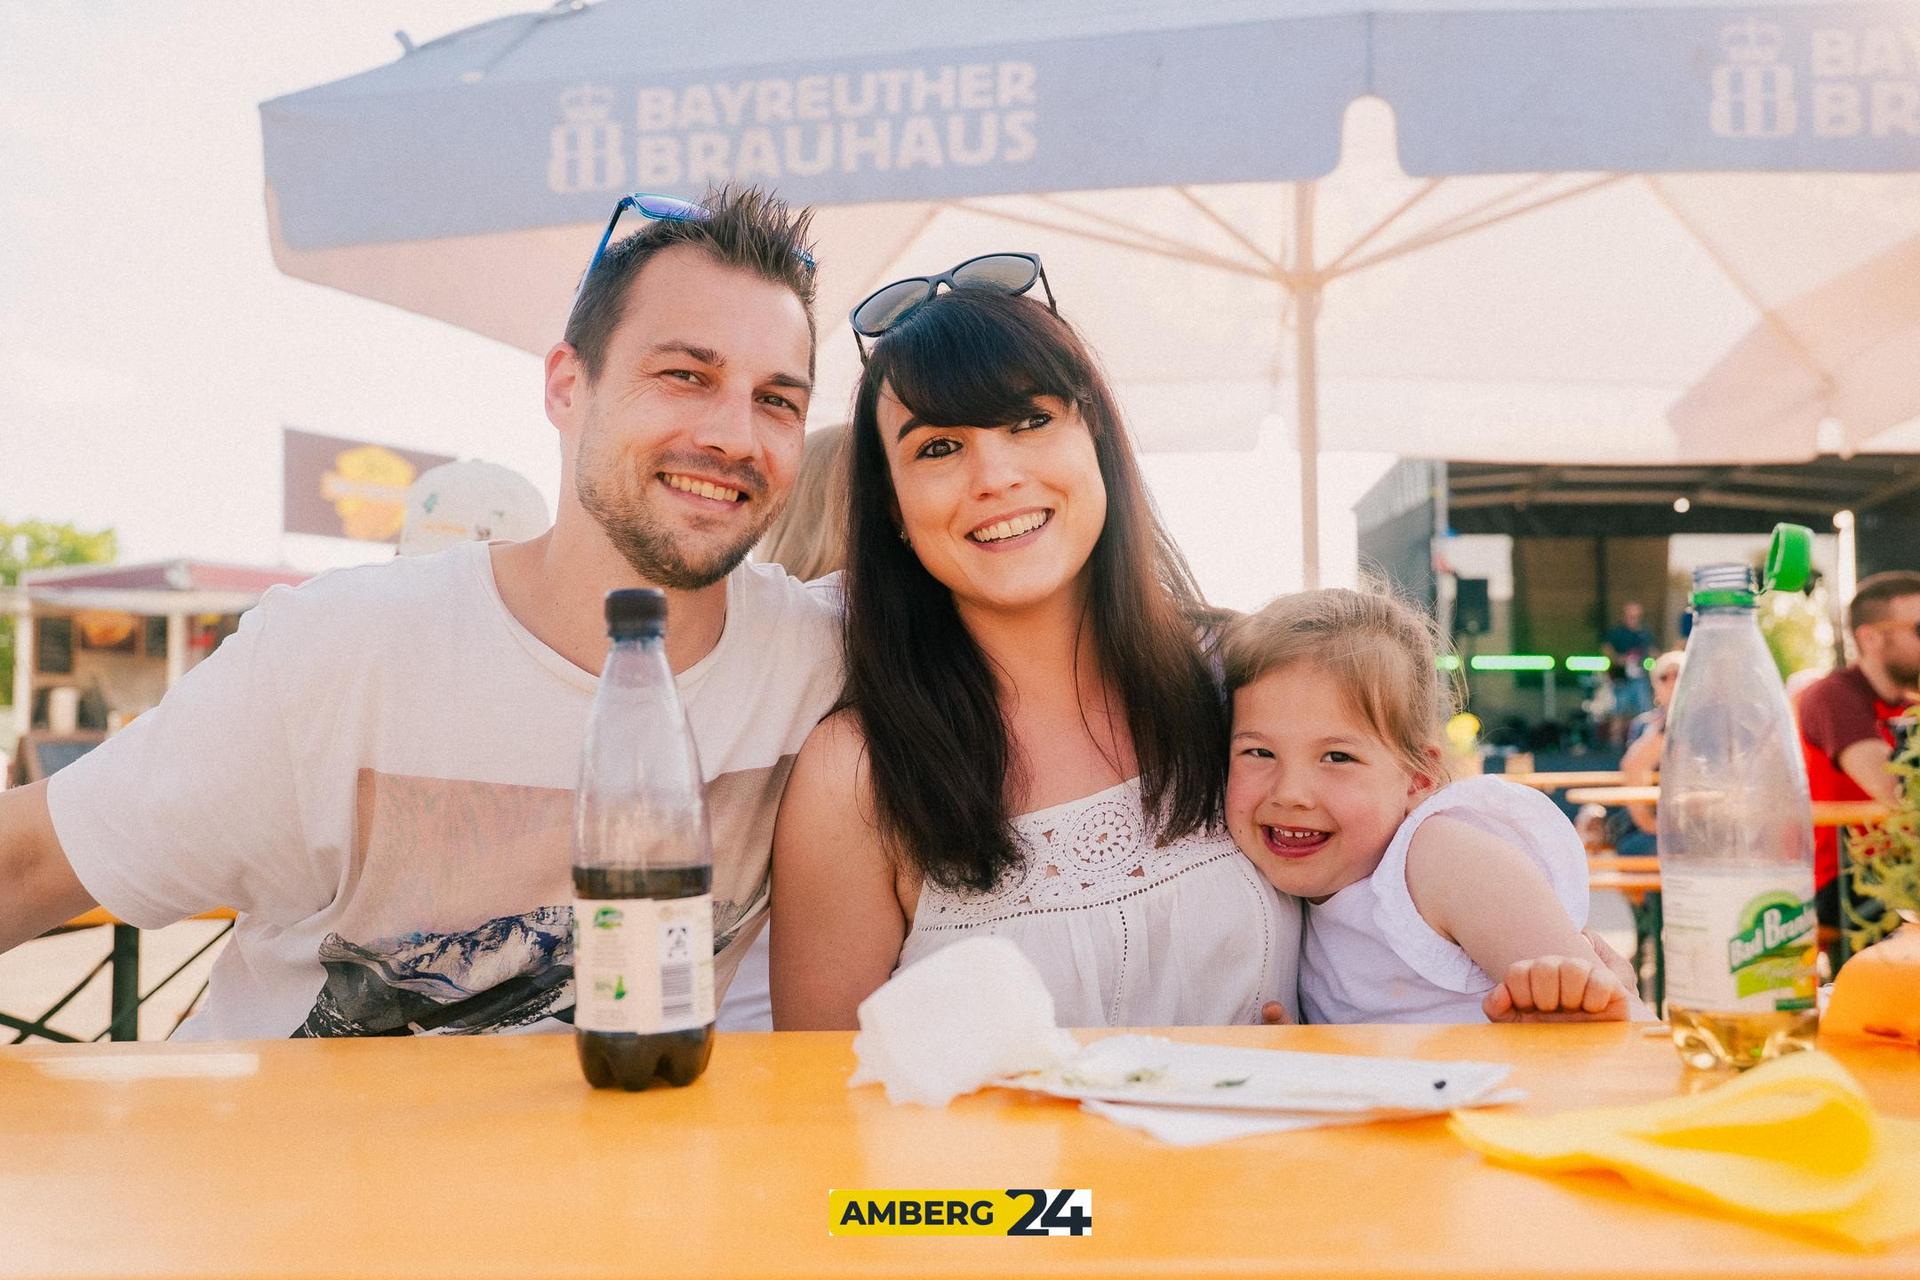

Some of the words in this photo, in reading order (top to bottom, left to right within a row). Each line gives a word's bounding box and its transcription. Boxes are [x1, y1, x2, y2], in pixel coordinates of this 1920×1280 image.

[636, 61, 1038, 130] BAYREUTHER
[1811, 80, 1920, 138] BR
[636, 110, 1038, 187] BRAUHAUS
